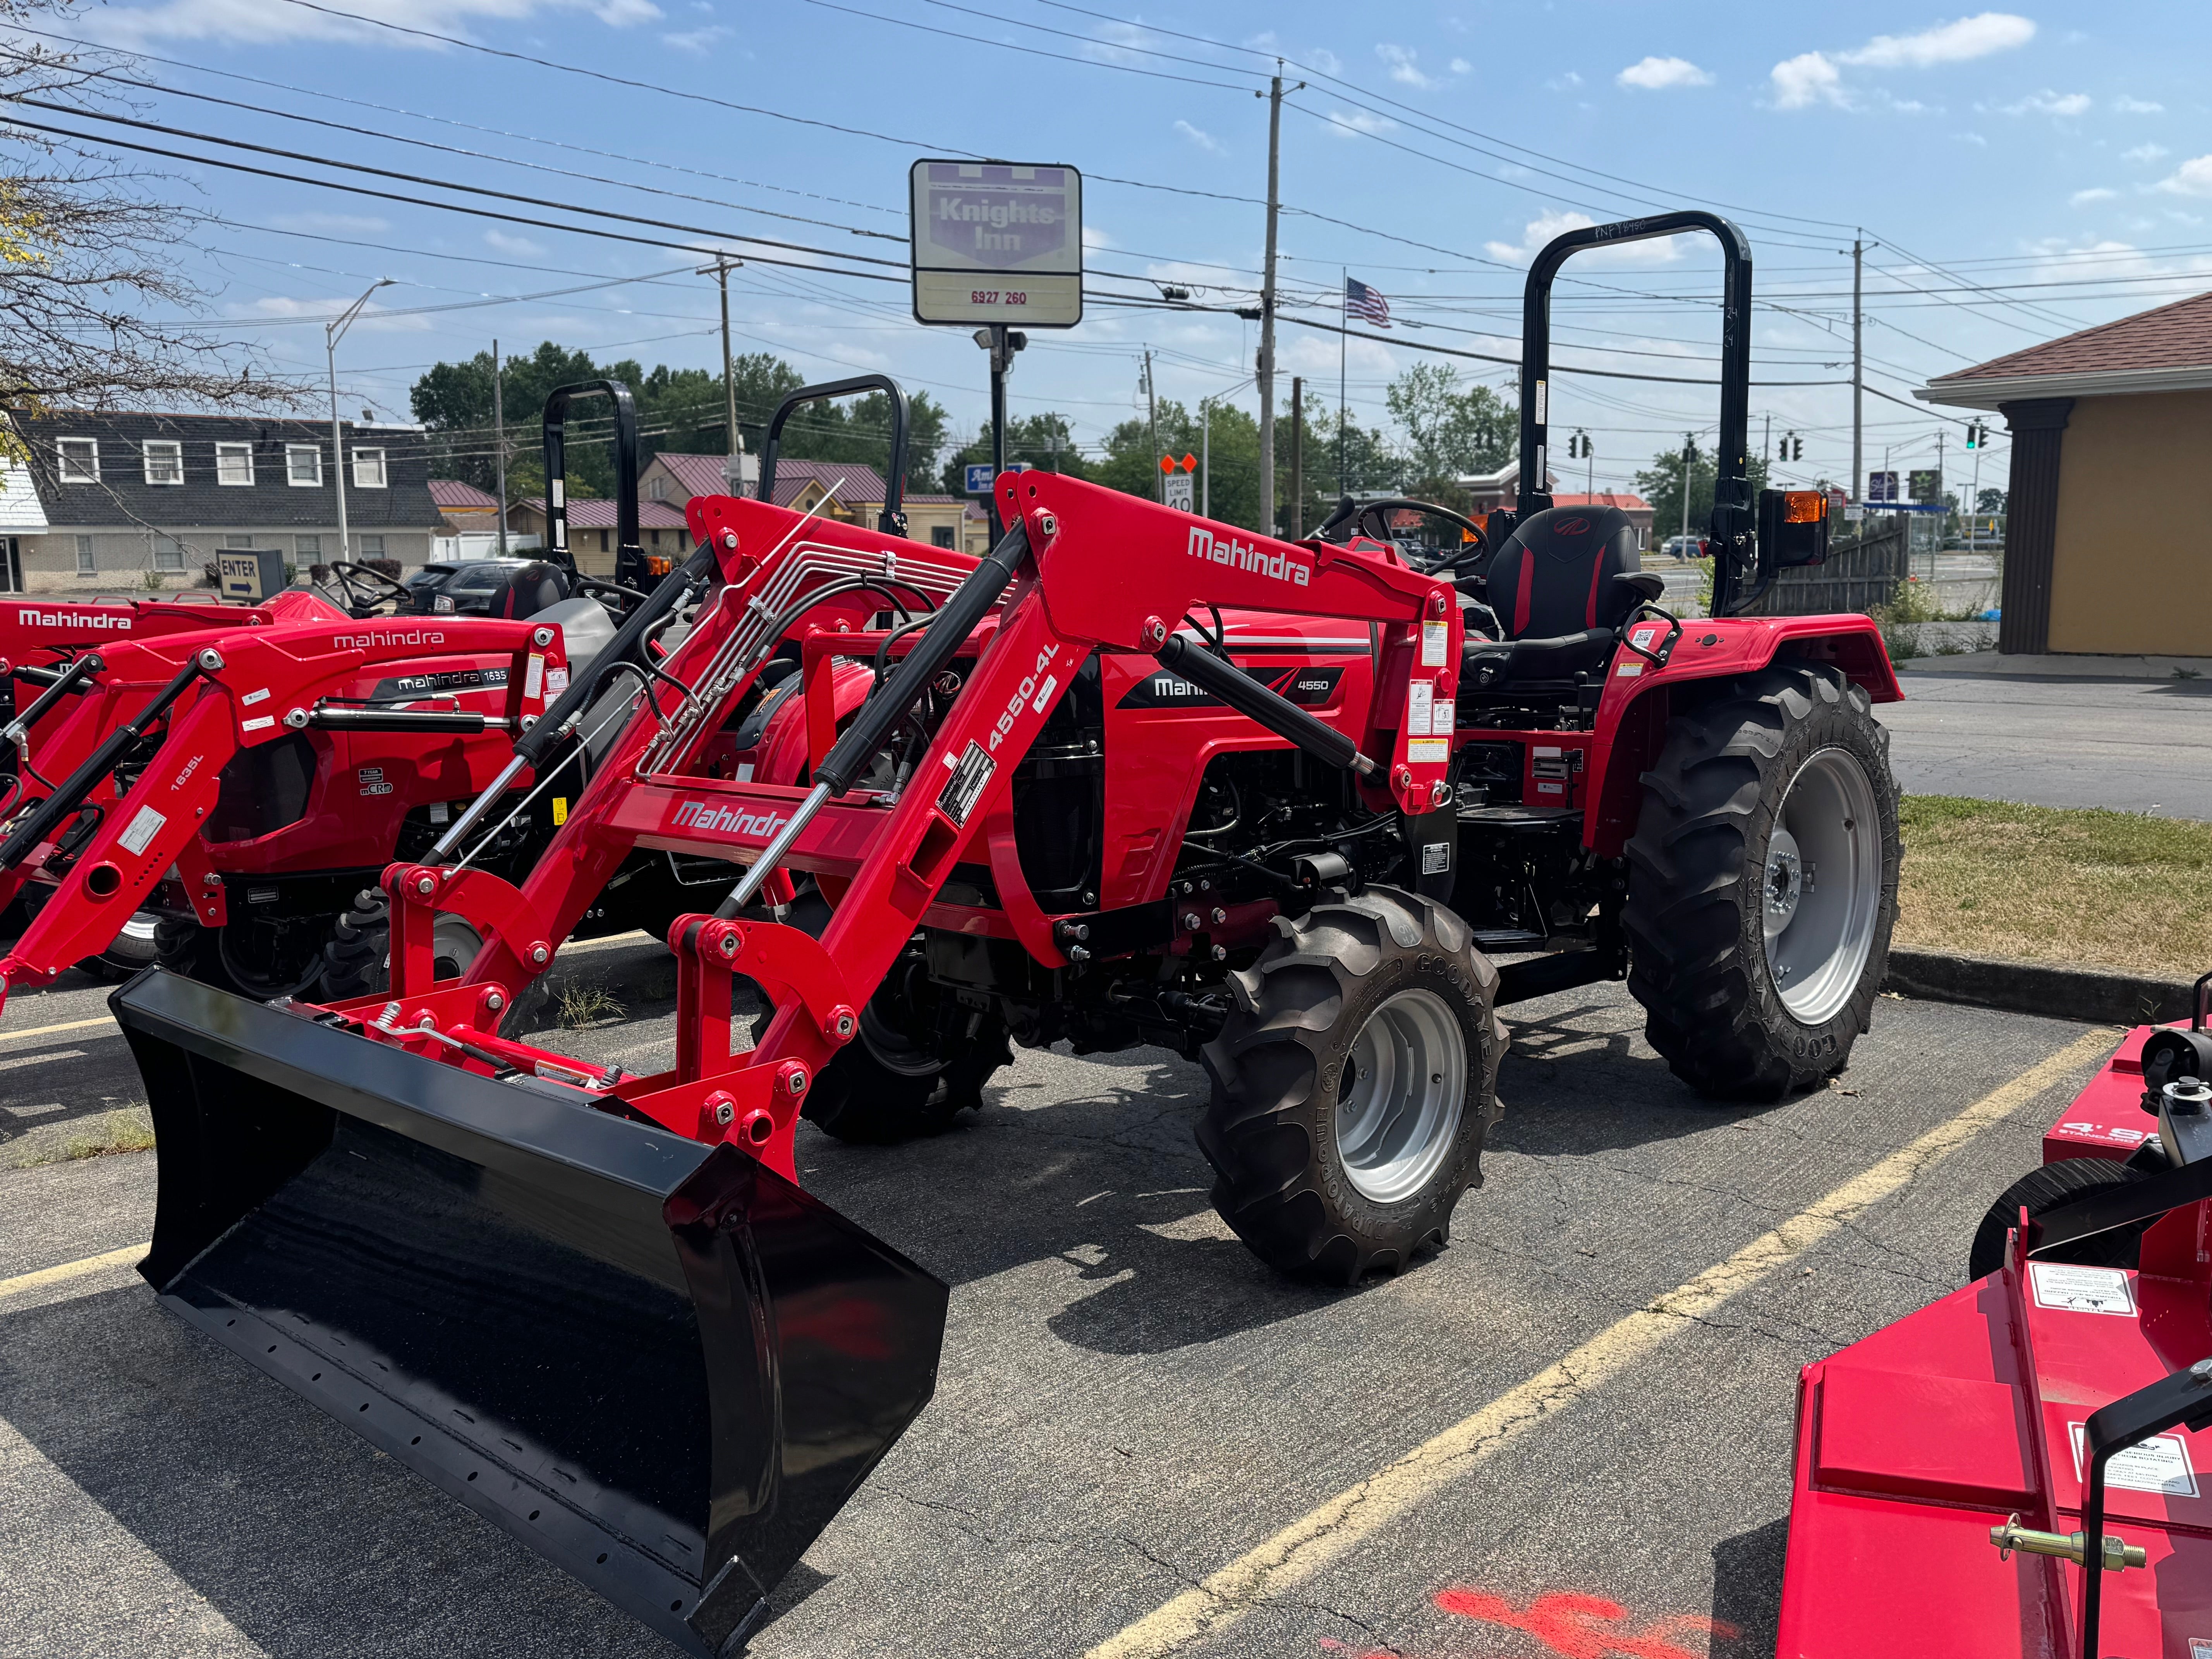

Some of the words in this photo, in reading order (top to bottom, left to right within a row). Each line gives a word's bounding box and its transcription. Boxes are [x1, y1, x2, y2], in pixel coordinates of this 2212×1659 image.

[939, 198, 1055, 228] Knights
[975, 226, 1021, 251] Inn
[971, 291, 999, 304] 6927
[1005, 292, 1027, 304] 260
[1169, 498, 1191, 512] 40
[1188, 526, 1310, 586] Mahindra
[222, 559, 256, 578] ENTER
[19, 610, 131, 629] Mahindra
[334, 630, 444, 648] mahindra
[398, 672, 479, 690] mahindra
[484, 671, 507, 681] 1635
[1298, 680, 1329, 690] 4550
[989, 643, 1060, 752] 4550-4L
[171, 754, 204, 791] 1635L
[939, 779, 957, 809] Mahindra
[671, 800, 789, 837] Mahindr
[1416, 953, 1493, 1118] GOODYEAR
[2058, 1129, 2135, 1144] STANDARD
